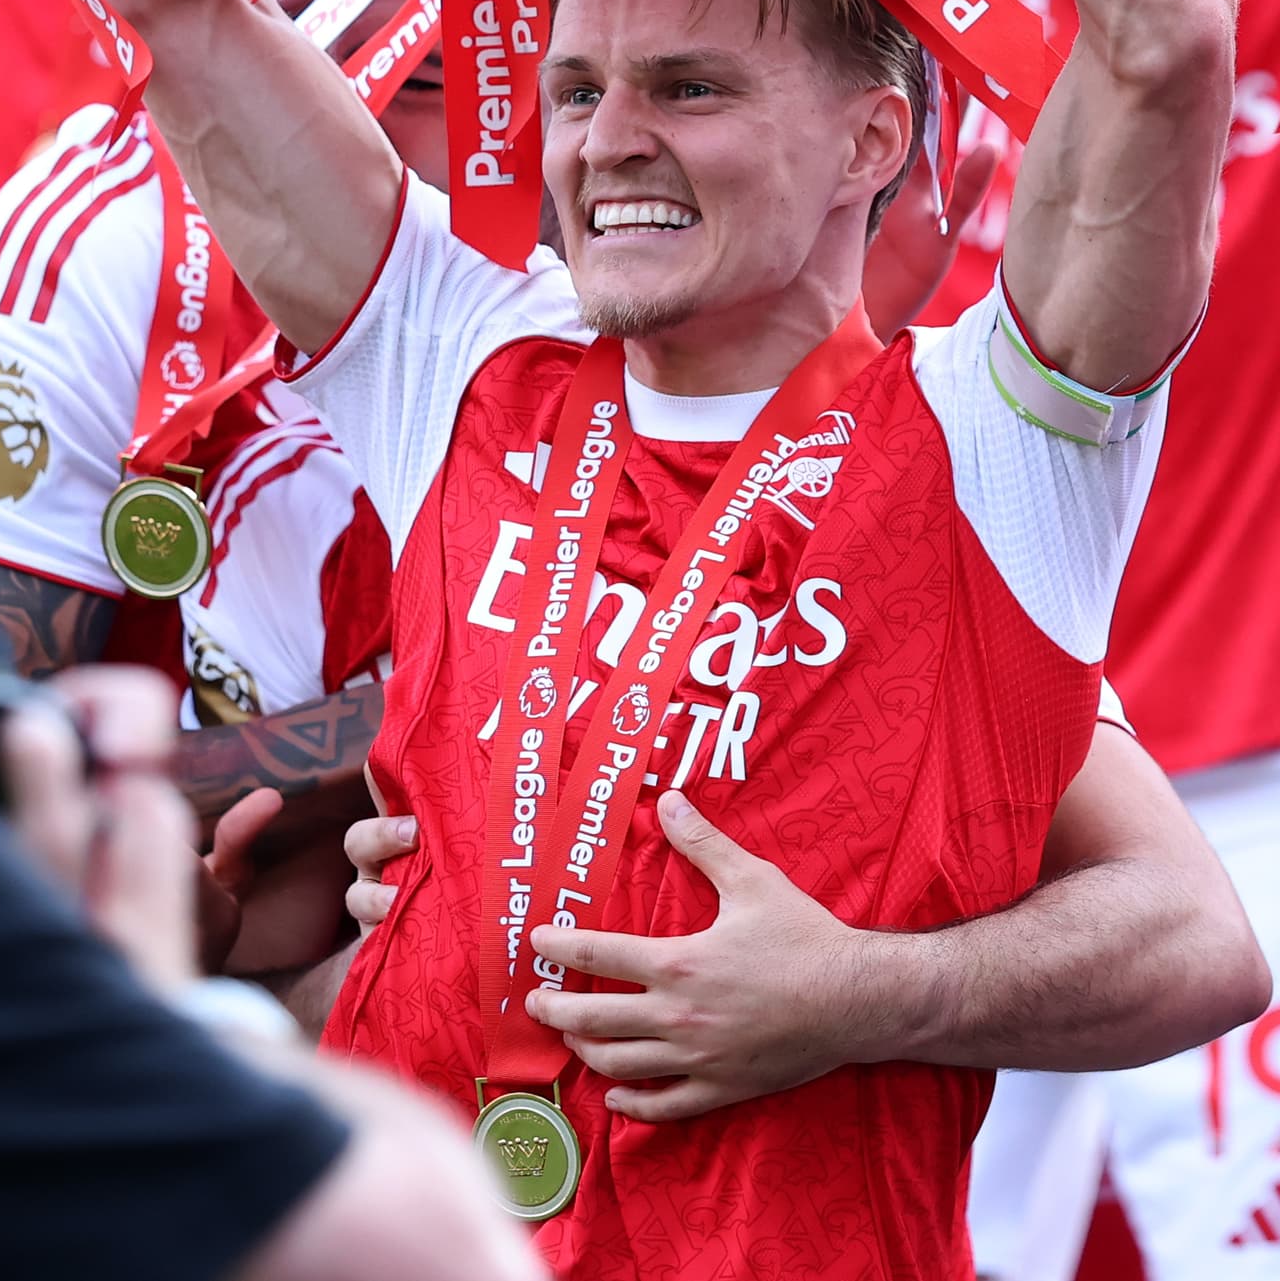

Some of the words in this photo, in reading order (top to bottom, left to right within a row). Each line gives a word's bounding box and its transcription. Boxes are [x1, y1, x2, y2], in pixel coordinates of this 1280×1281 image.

[174, 212, 211, 334] League
[553, 399, 619, 520] League
[526, 524, 583, 658] Premier
[637, 547, 727, 676] League
[500, 726, 547, 868] League
[566, 741, 638, 884] Premier
